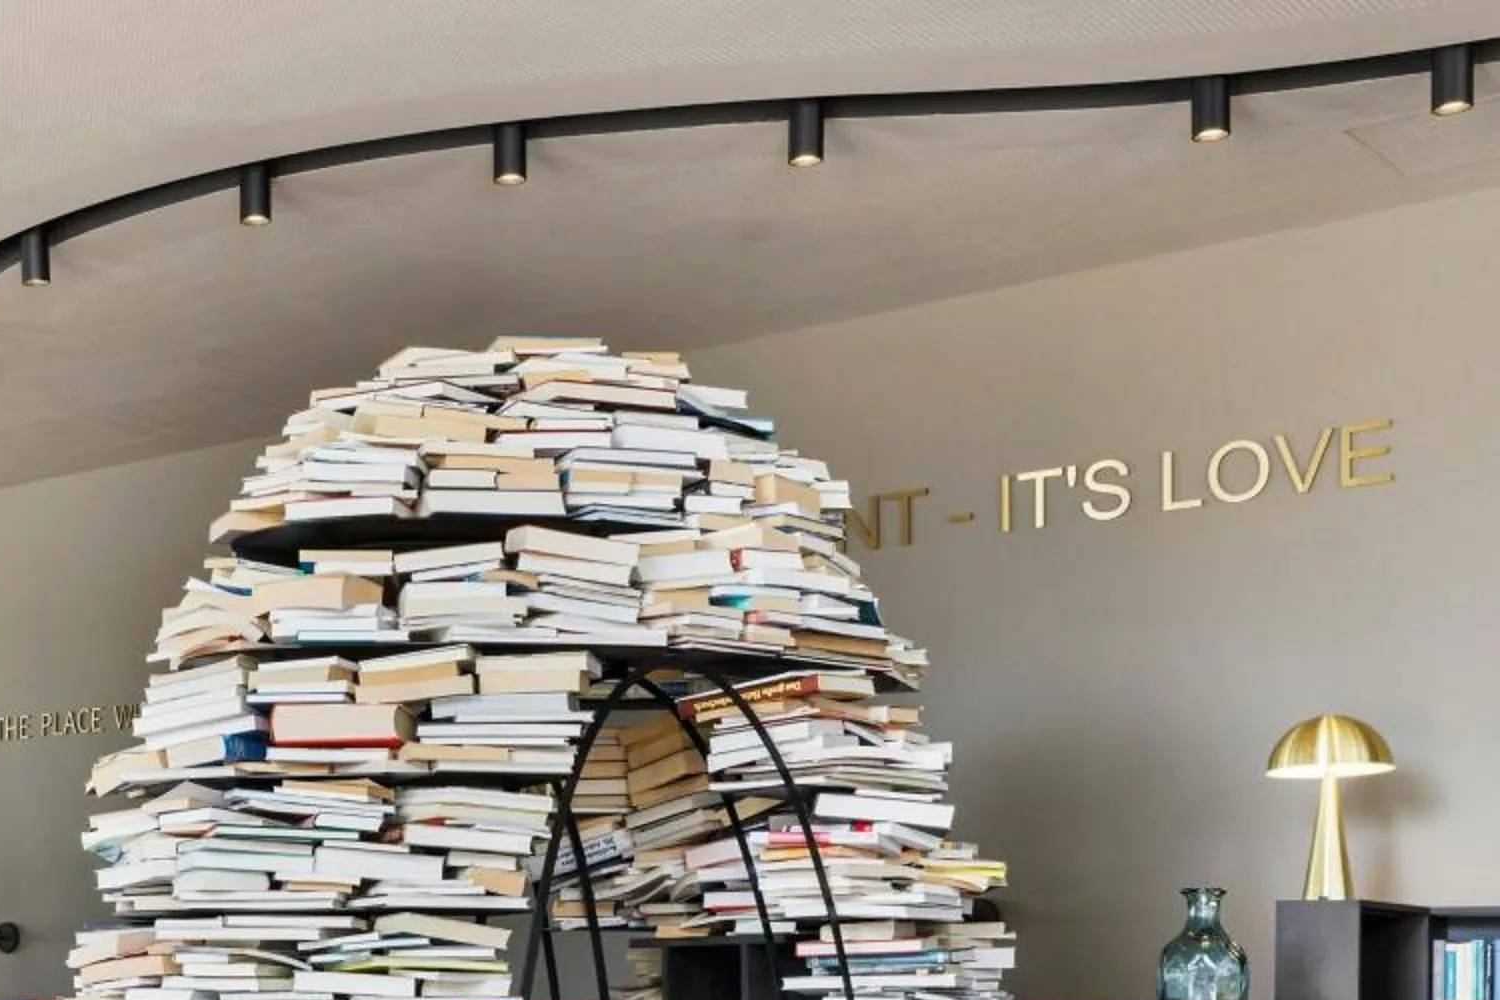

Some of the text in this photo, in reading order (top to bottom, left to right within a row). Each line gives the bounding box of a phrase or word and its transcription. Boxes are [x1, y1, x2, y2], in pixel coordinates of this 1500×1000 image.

[1000, 459, 1132, 533] IT'S
[1162, 418, 1395, 512] LOVE
[41, 707, 102, 737] PLACE
